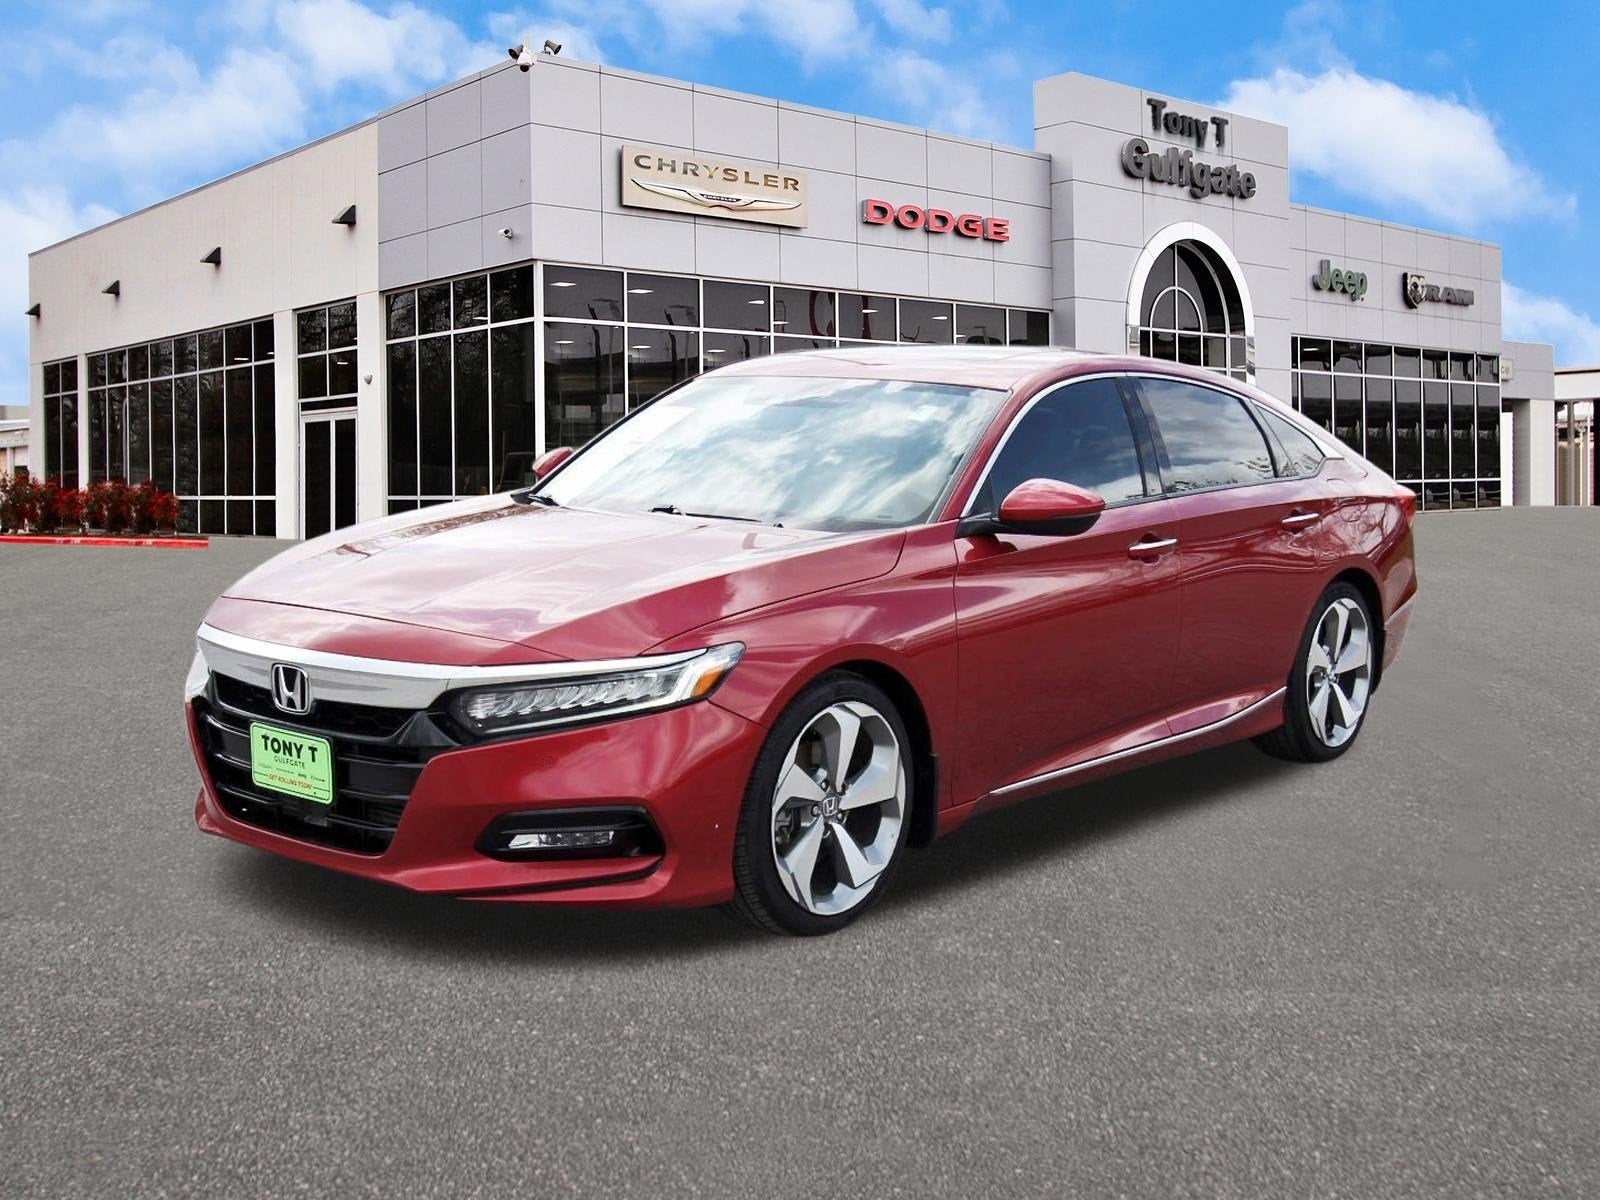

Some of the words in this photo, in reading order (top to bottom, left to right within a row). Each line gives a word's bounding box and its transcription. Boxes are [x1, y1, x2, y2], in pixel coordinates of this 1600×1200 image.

[1147, 98, 1208, 148] Tony
[1211, 117, 1229, 147] T
[634, 154, 800, 191] CHRYSLER
[1121, 138, 1257, 199] Gulfgate
[862, 198, 1011, 242] DODGE
[1312, 259, 1368, 301] Jeep
[1425, 284, 1474, 307] RAM
[261, 734, 303, 759] TONY
[308, 746, 318, 763] T
[274, 755, 305, 769] GULFGATE
